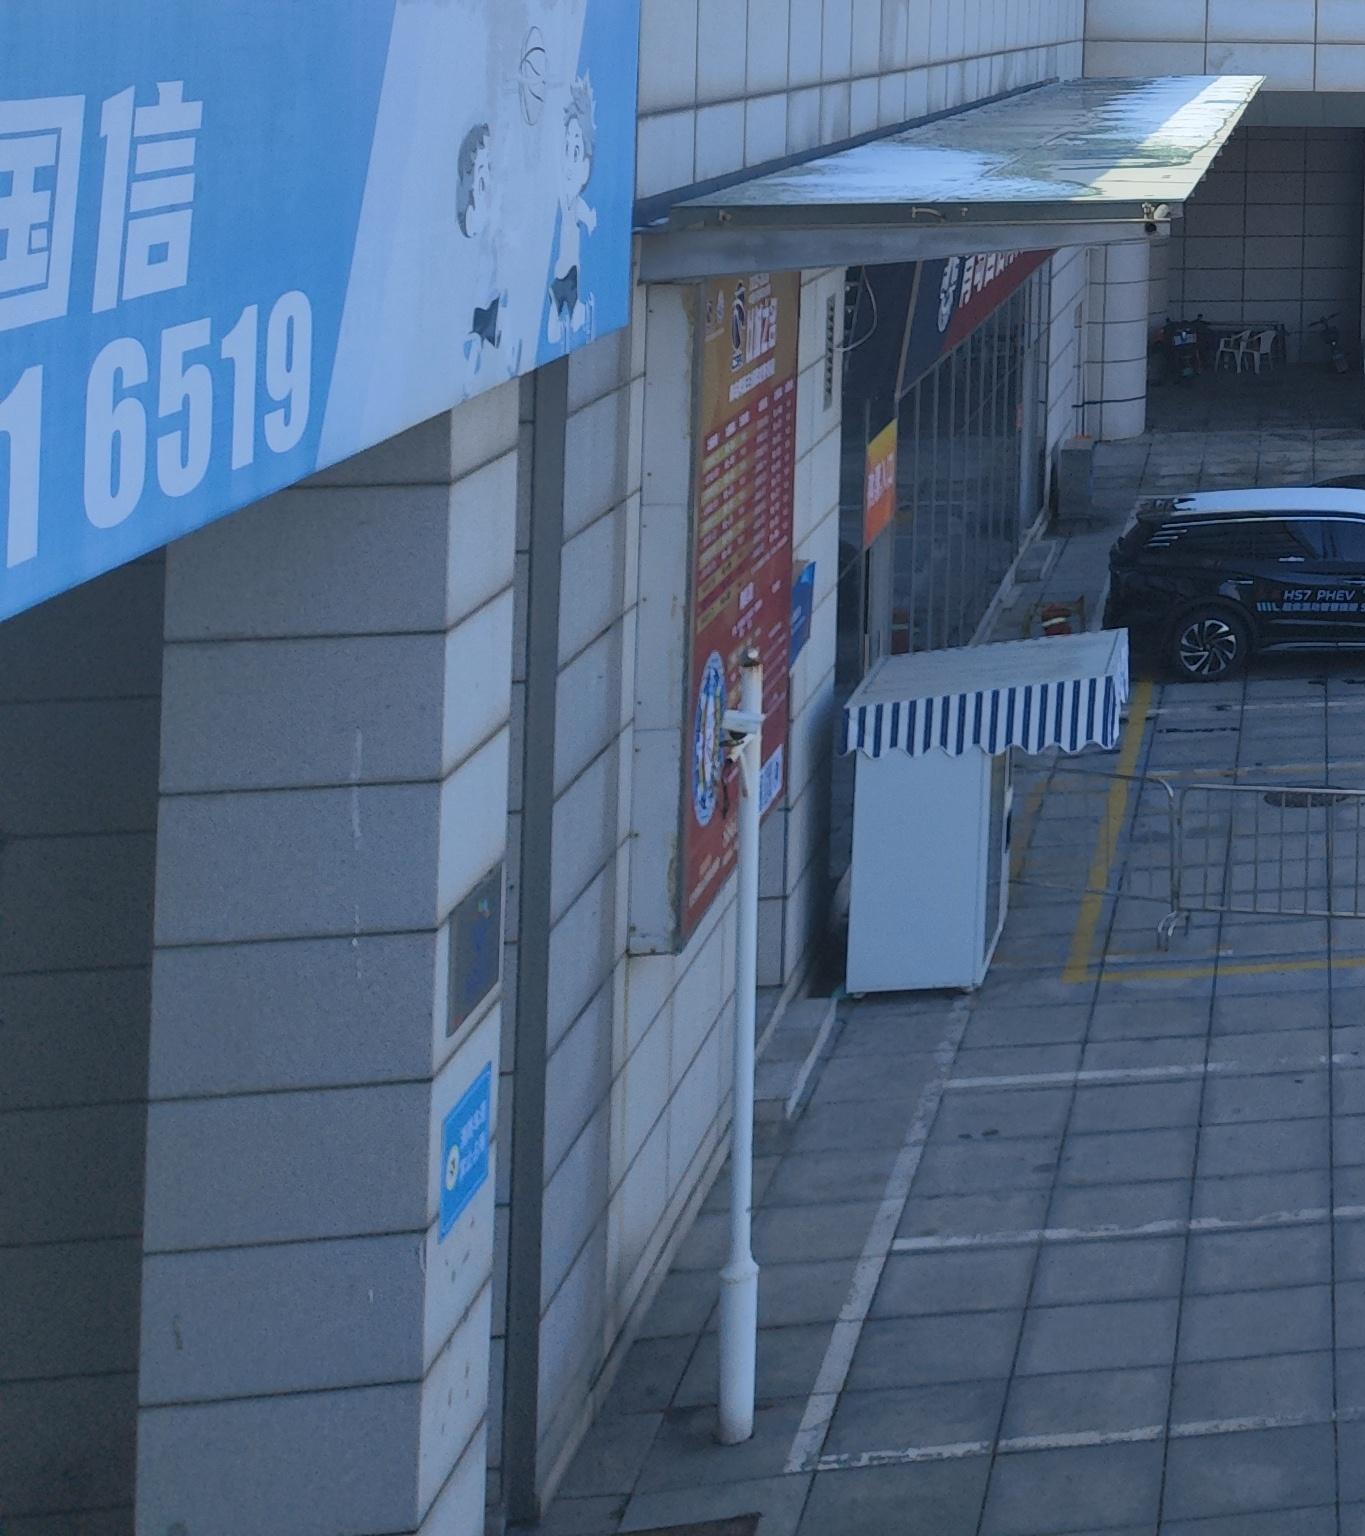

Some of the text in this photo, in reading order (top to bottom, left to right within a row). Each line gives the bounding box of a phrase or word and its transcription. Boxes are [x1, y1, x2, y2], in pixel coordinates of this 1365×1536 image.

[0, 80, 203, 331] 国信
[84, 290, 313, 529] 6519
[1283, 590, 1356, 601] HS7 PHEV
